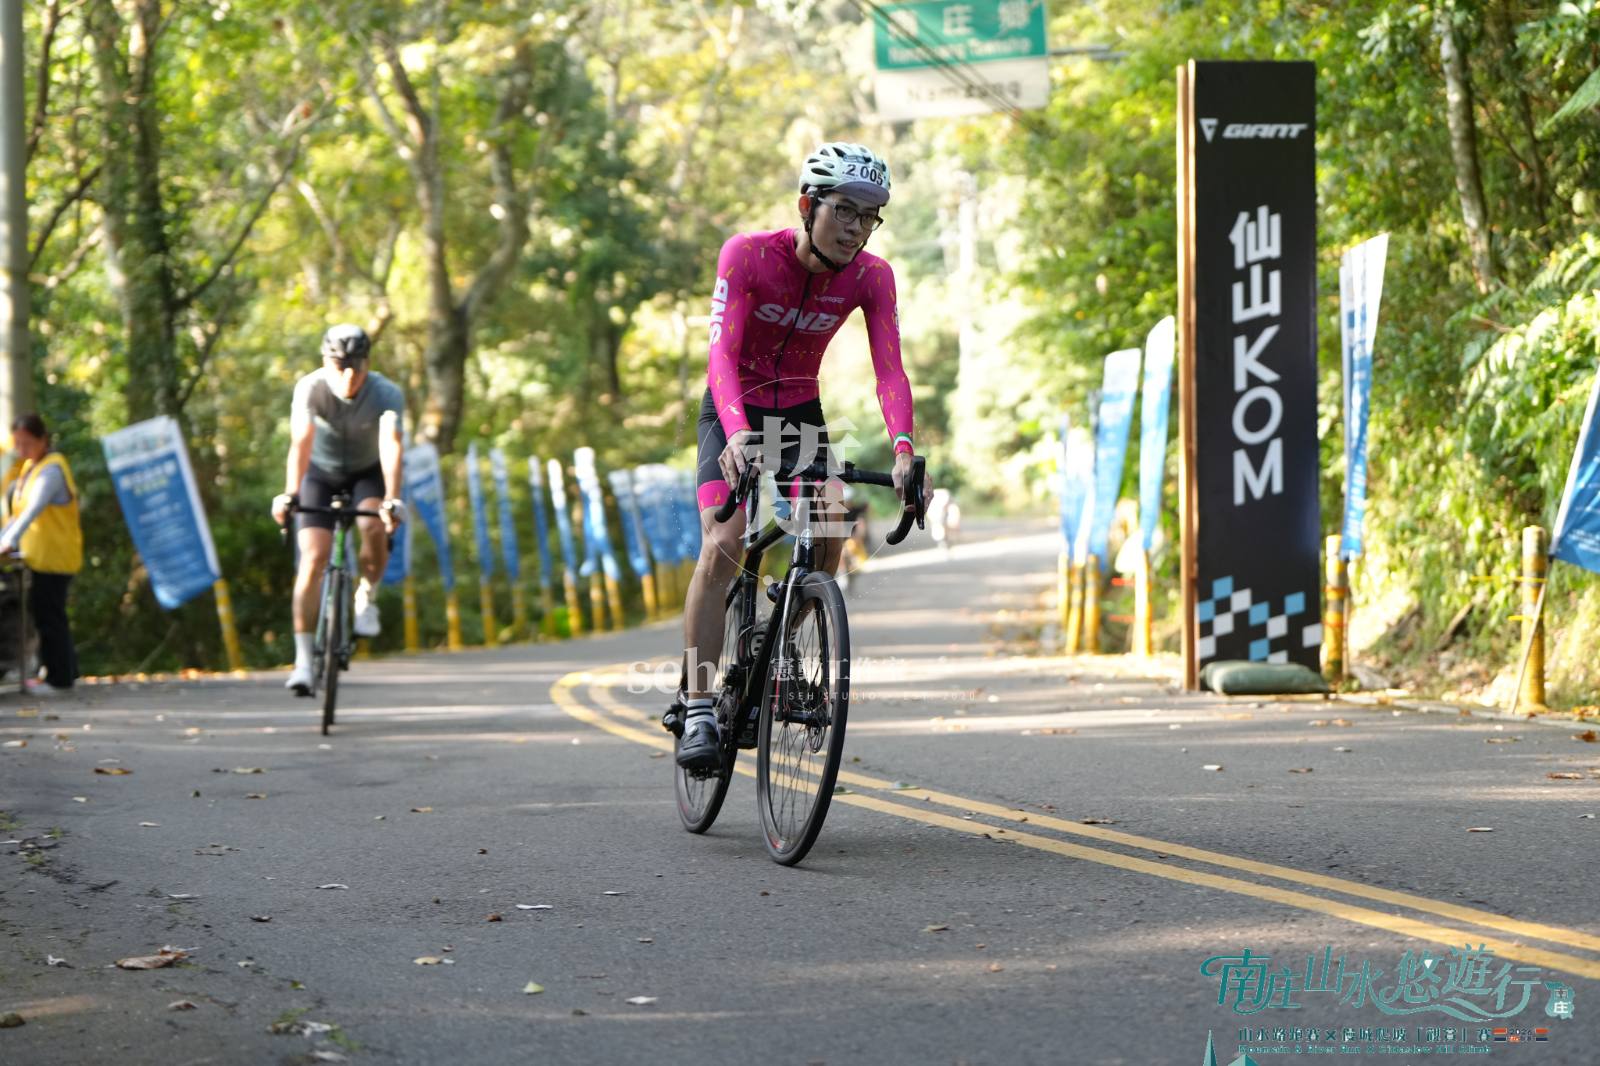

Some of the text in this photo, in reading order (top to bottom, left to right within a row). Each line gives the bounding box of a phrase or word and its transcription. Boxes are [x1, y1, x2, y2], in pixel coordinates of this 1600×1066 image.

[1222, 123, 1308, 138] GIANT
[709, 276, 729, 345] SNB
[754, 303, 840, 331] SNB
